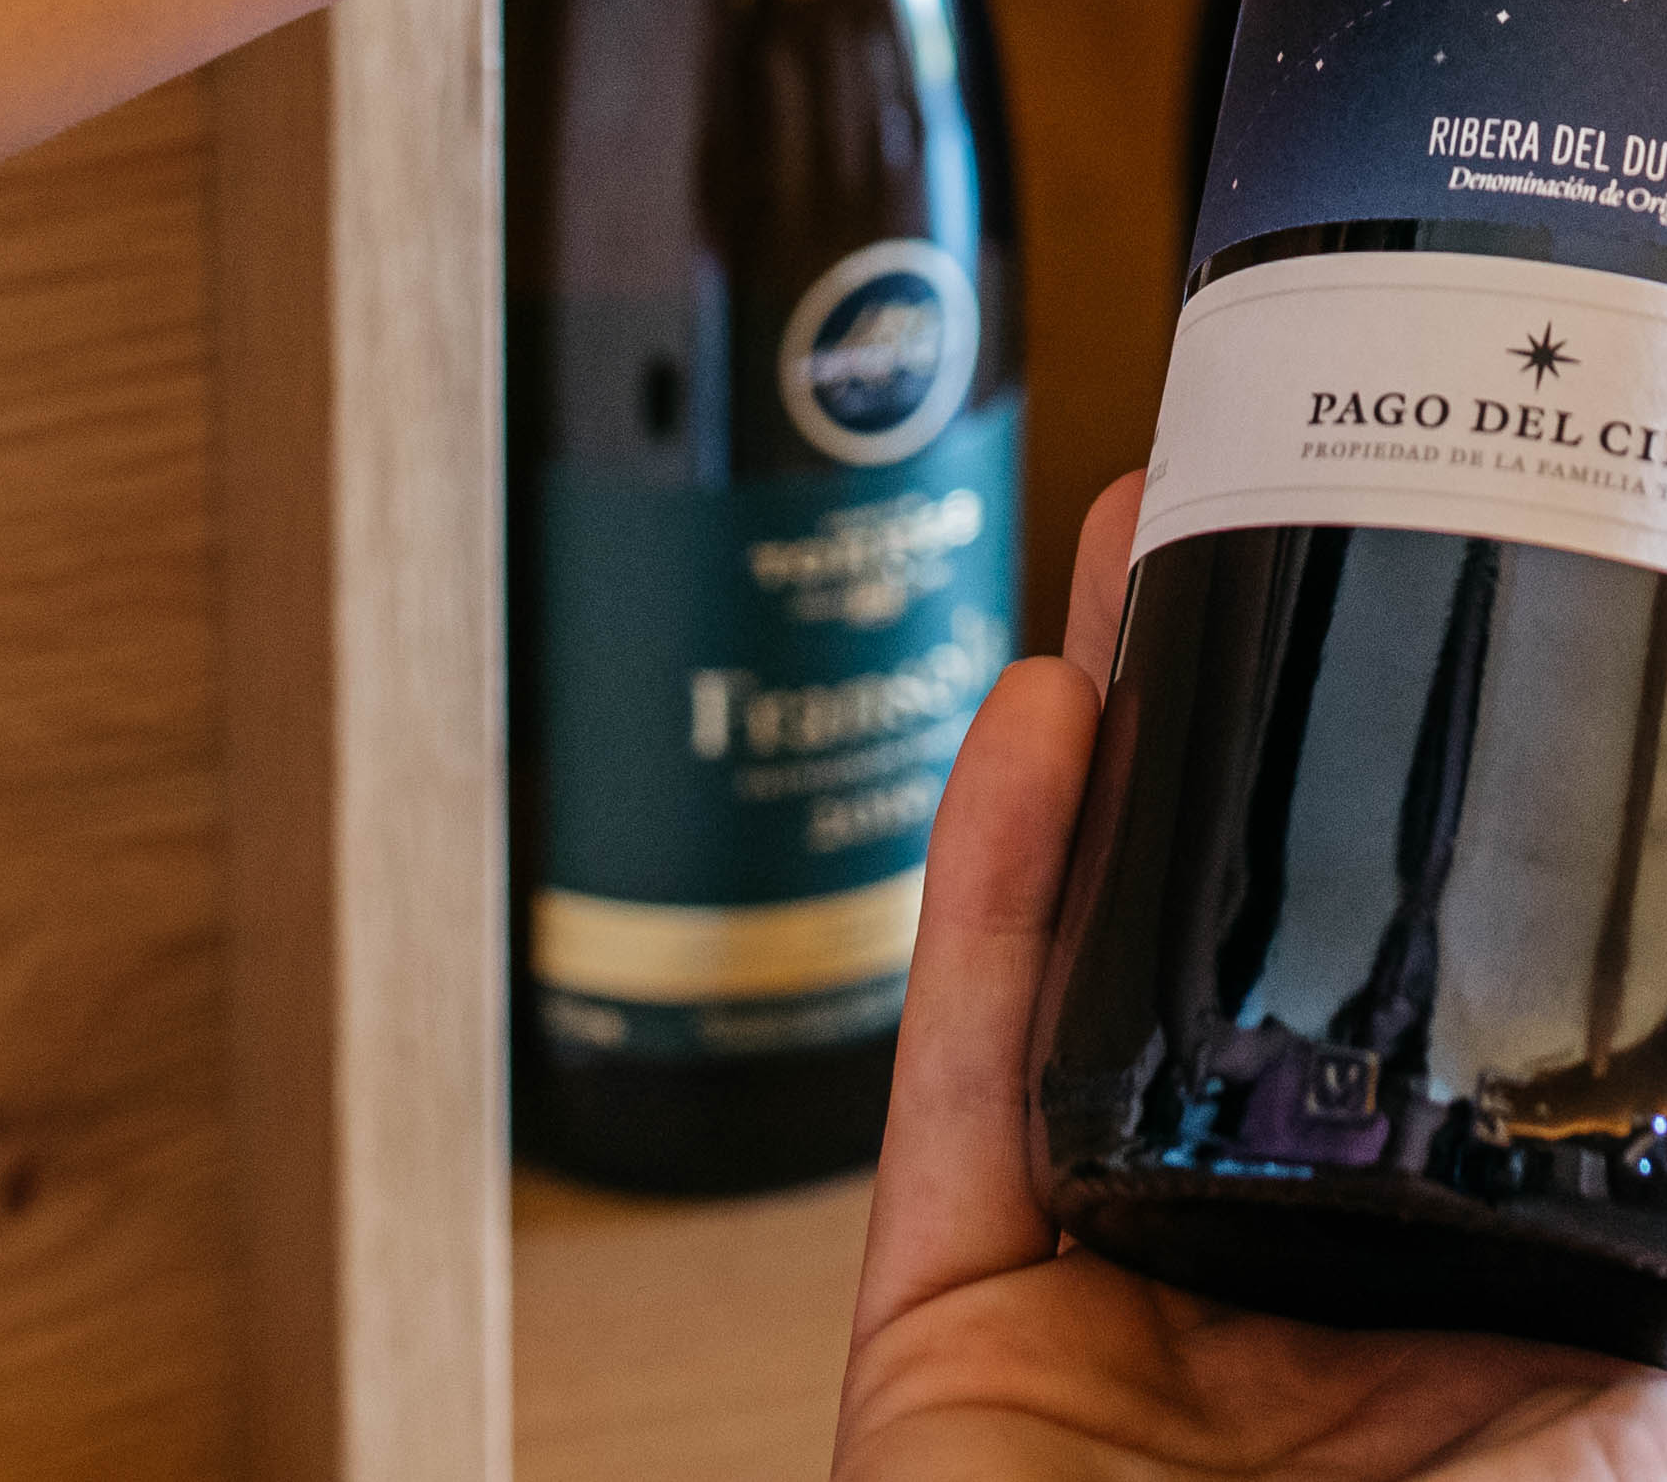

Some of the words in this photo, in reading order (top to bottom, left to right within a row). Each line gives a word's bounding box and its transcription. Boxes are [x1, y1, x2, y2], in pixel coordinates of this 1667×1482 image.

[1428, 116, 1539, 162] RIBERA
[1551, 123, 1610, 172] DEL
[1448, 165, 1597, 204] Denominación
[1598, 178, 1625, 208] de
[1307, 391, 1451, 428] PAGO
[1469, 398, 1584, 449] DEL
[1301, 441, 1437, 463] PROPIEDAD
[1449, 449, 1485, 469] DE
[1495, 452, 1528, 474] LA
[1536, 460, 1648, 497] FAMILIA
